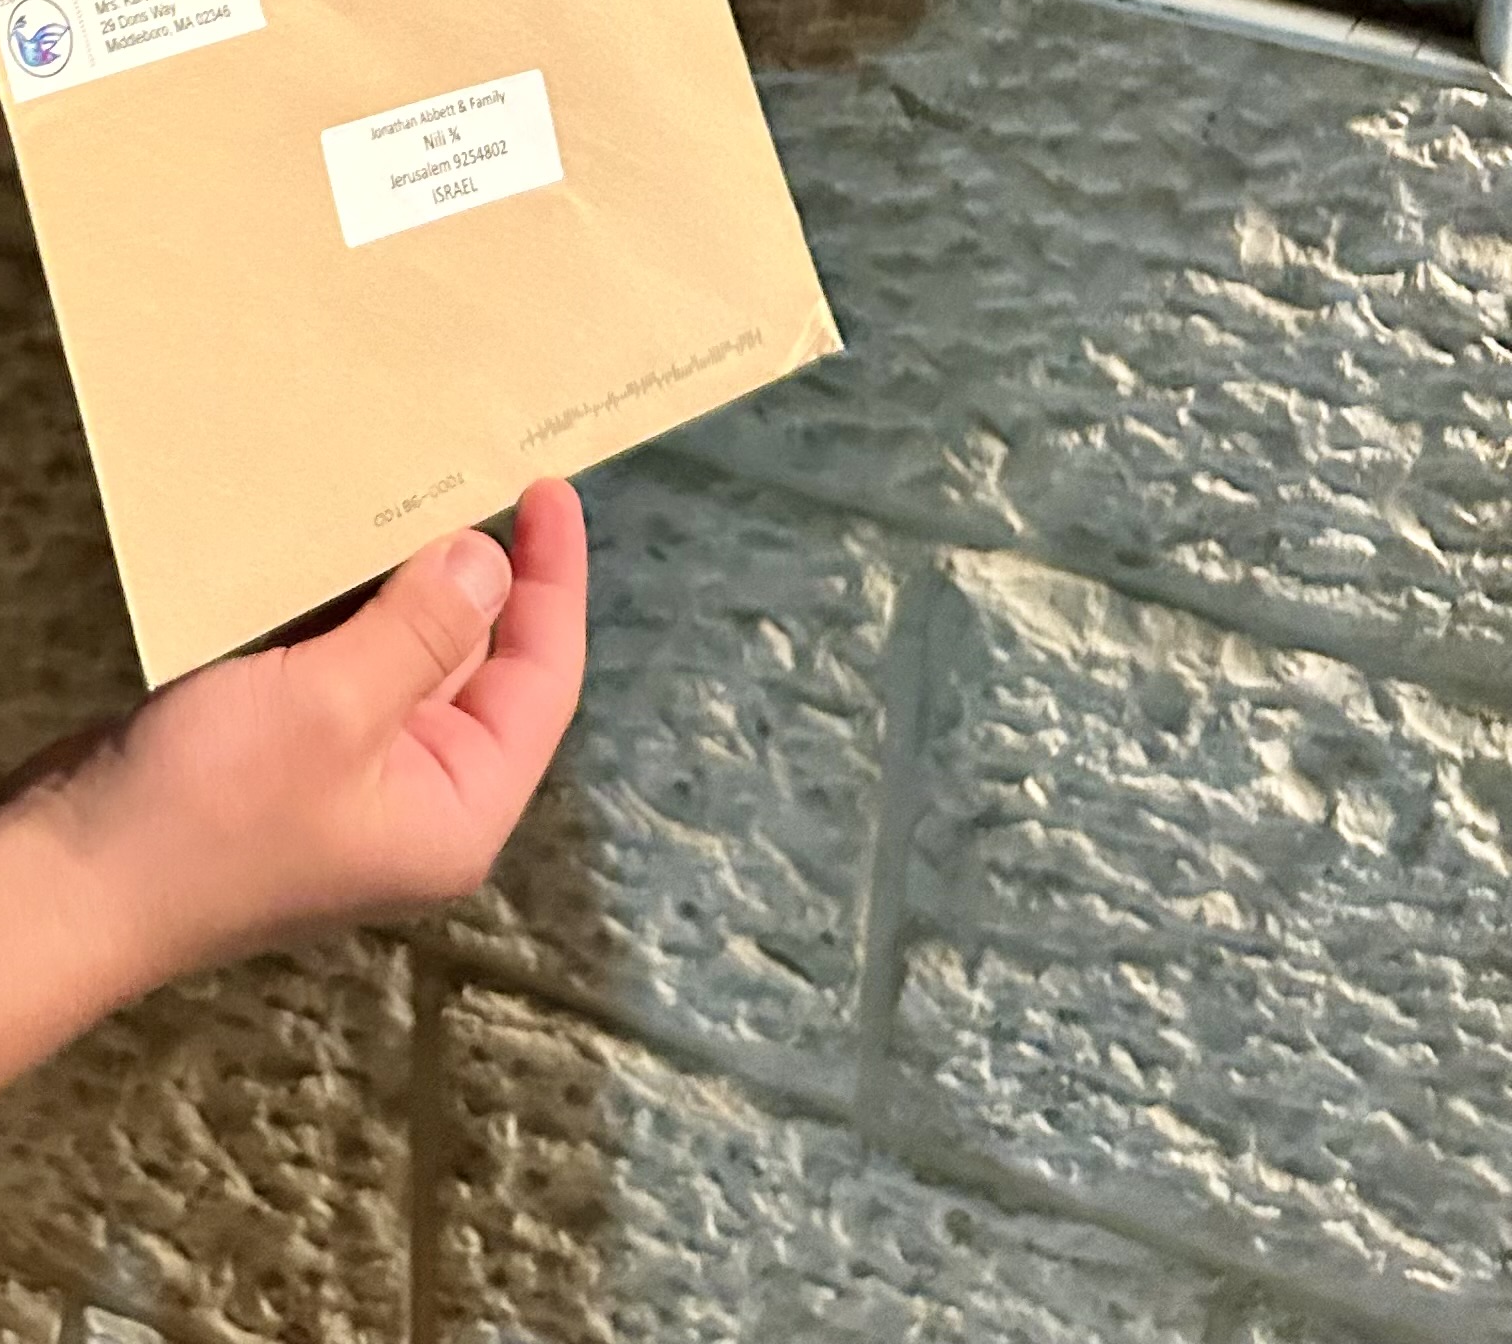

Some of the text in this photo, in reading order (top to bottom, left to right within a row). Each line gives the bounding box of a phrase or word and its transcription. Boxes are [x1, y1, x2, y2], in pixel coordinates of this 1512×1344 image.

[150, 2, 178, 22] Way
[175, 18, 195, 35] MA
[370, 89, 507, 141] Jonathan Abbett & Family
[422, 132, 448, 152] Nili
[390, 139, 509, 190] Jerusalem 9254802
[431, 176, 479, 205] ISRAEL
